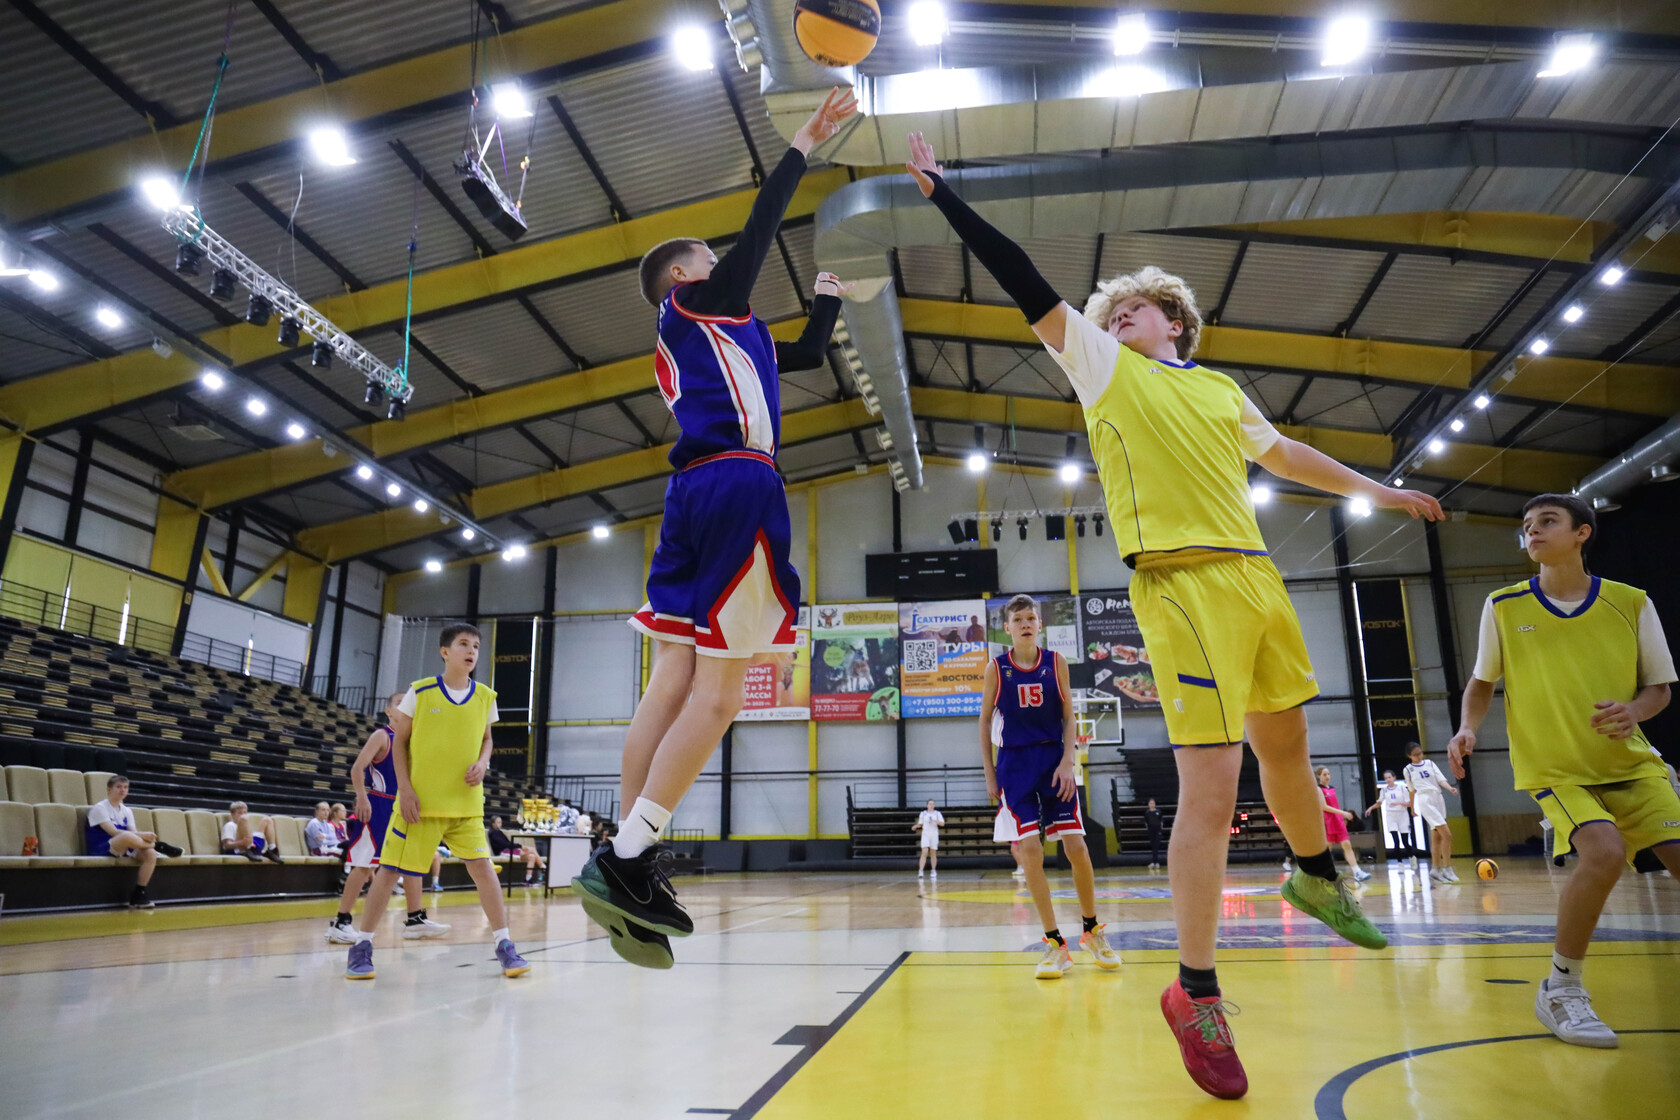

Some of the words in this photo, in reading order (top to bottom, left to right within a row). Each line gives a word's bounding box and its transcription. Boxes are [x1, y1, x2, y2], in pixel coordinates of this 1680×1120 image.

[917, 614, 968, 623] САХТУРИСТ
[943, 641, 985, 654] ТУРЫ
[1017, 683, 1044, 708] 15
[1373, 718, 1414, 728] VOSTOK
[1419, 770, 1430, 779] 15
[1140, 929, 1558, 944] VOSOK
